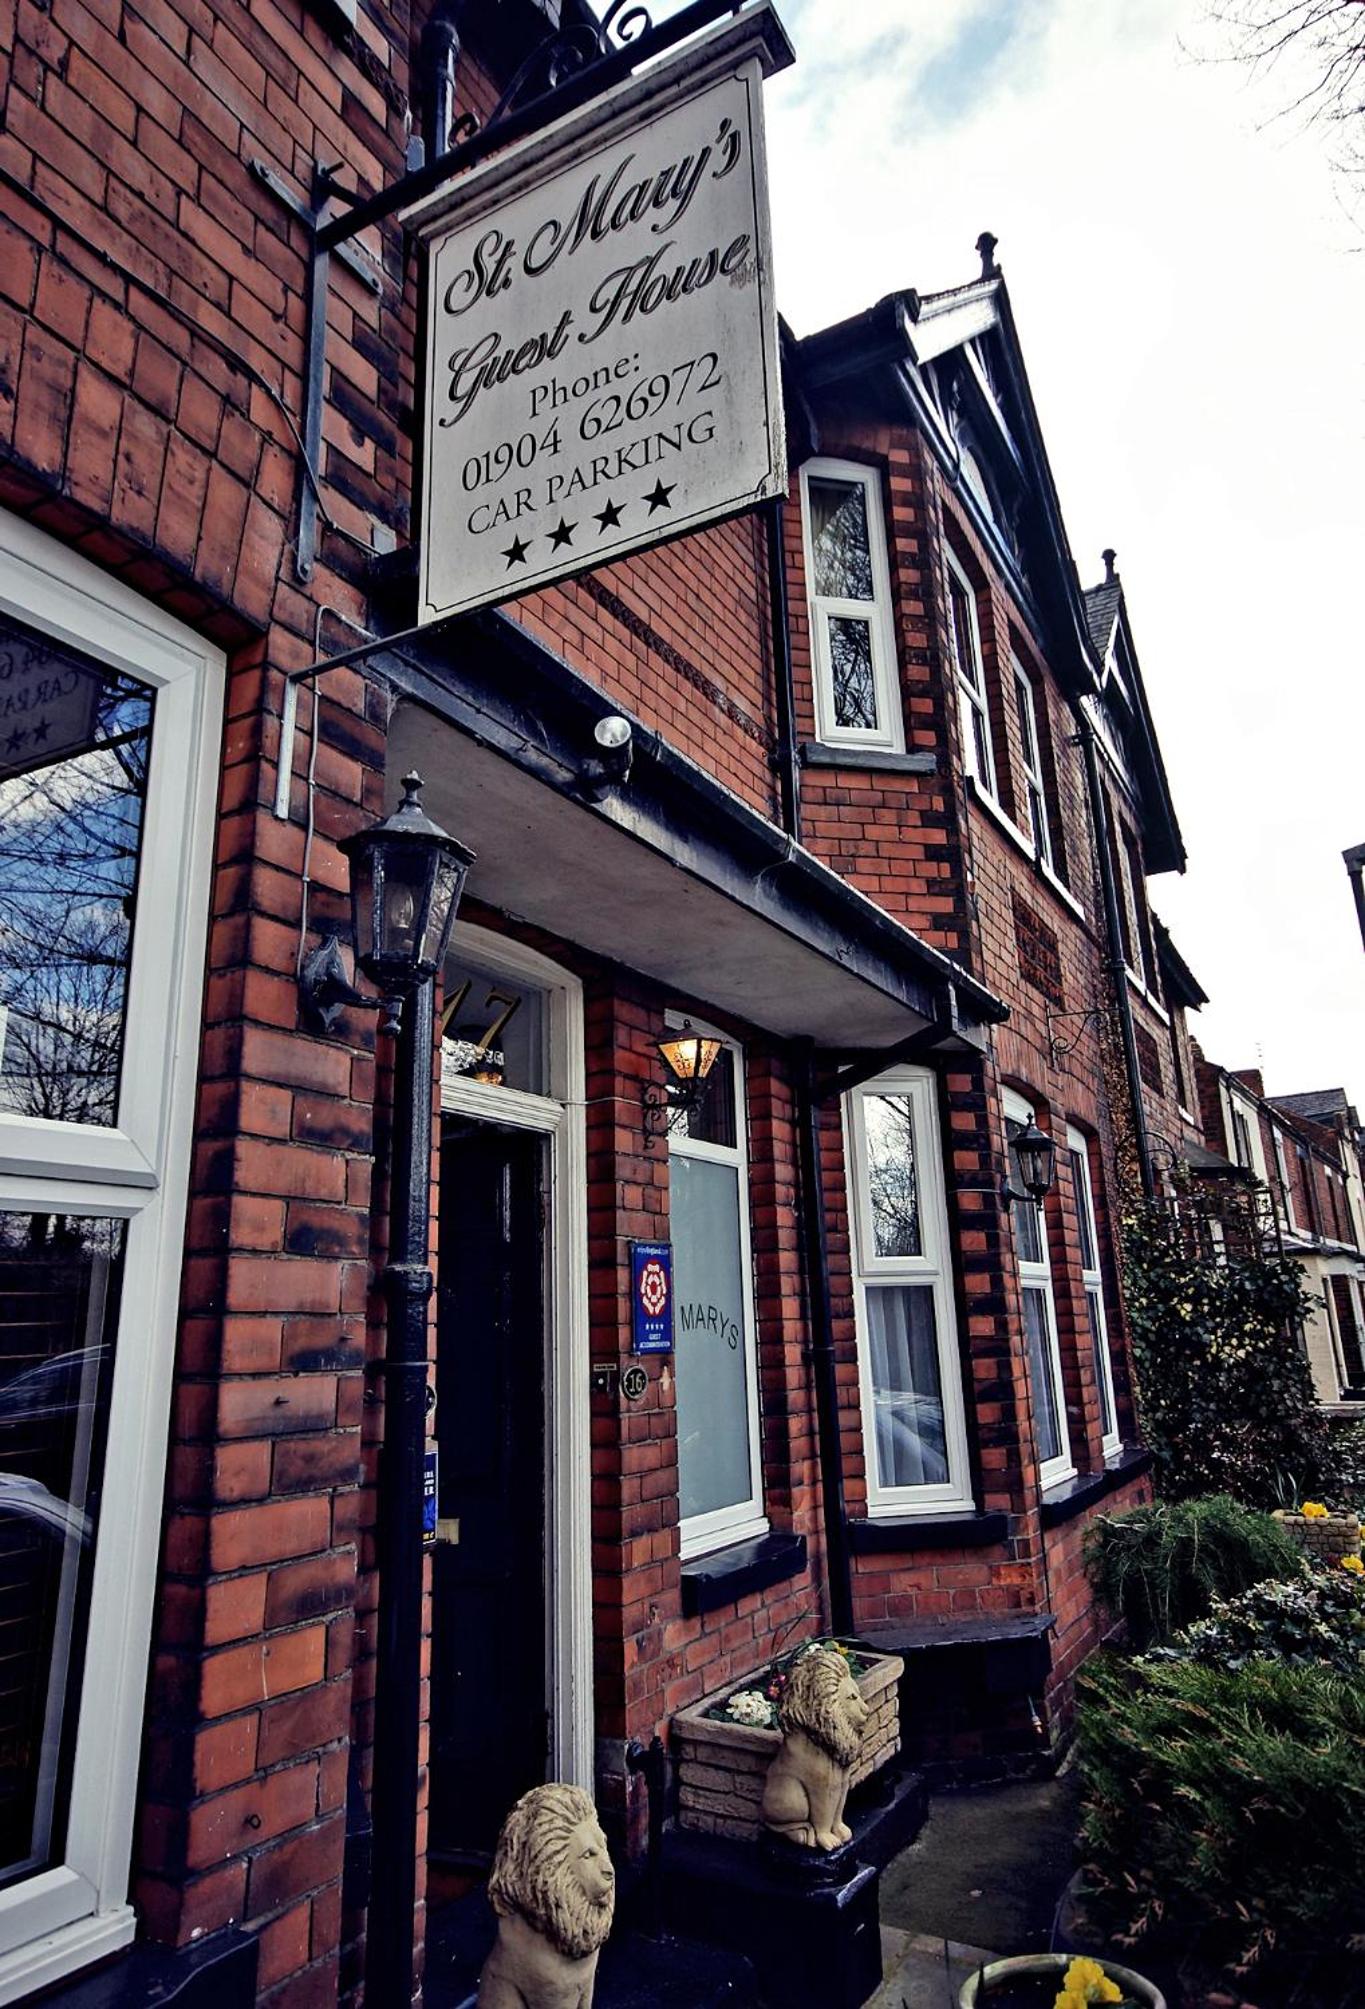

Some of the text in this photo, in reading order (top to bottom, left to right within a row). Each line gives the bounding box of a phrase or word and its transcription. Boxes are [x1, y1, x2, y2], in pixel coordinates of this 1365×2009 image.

[444, 117, 741, 317] St. Mary's
[438, 233, 751, 428] Guest House
[529, 352, 641, 419] Phone:
[461, 351, 723, 492] 01904 626972
[467, 410, 717, 535] CAR PARKING
[629, 1375, 644, 1393] 16
[680, 1303, 739, 1351] MARYS
